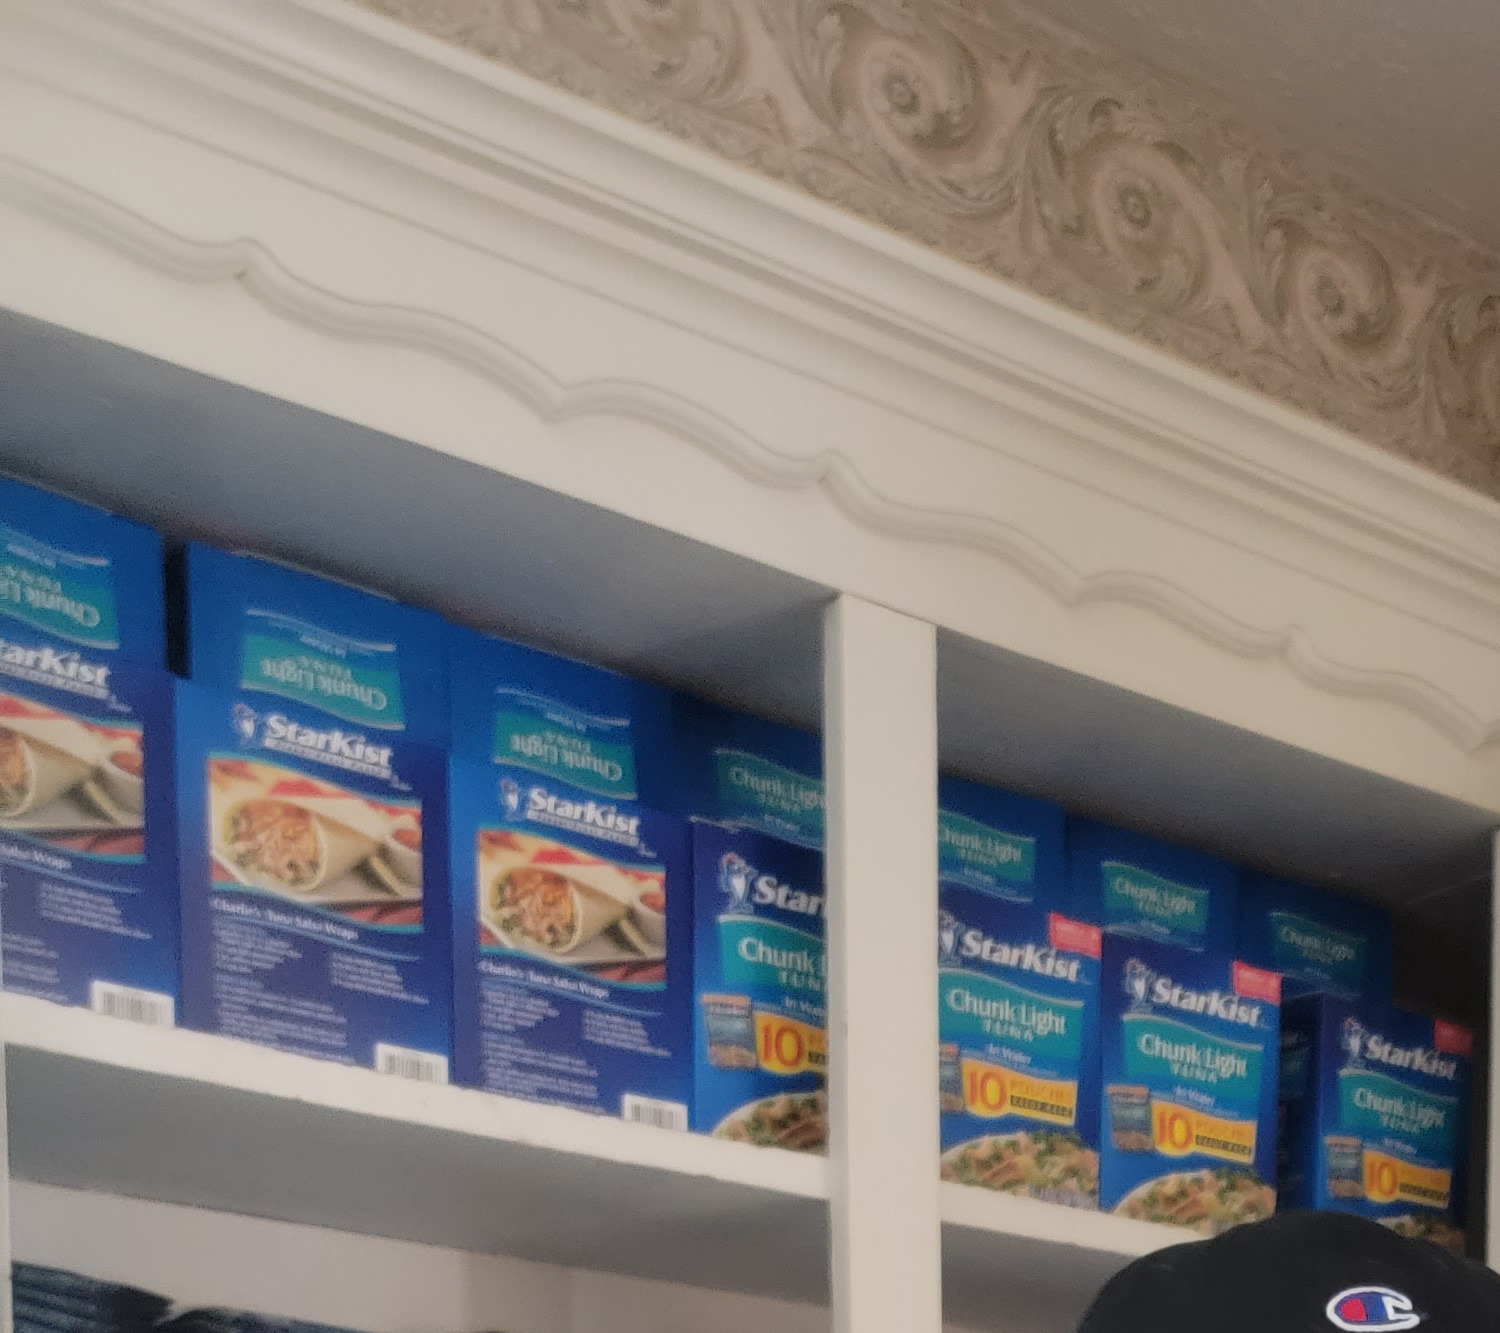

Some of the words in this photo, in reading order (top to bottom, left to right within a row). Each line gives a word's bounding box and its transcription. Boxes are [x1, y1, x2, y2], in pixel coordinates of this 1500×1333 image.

[0, 637, 112, 688] arKist
[260, 657, 315, 693] Light
[318, 674, 388, 711] Chunk
[266, 713, 394, 767] StarKist
[510, 734, 560, 765] Light
[563, 750, 624, 782] Chunk
[729, 766, 788, 797] Chunk
[790, 783, 825, 809] Ligh
[528, 786, 643, 836] StarKist
[940, 826, 987, 849] hunk
[754, 875, 825, 915] Star
[738, 935, 821, 974] Chunk
[962, 928, 1081, 983] StarKist
[779, 968, 826, 992] TUN
[948, 987, 1016, 1021] Chunk
[1021, 1004, 1067, 1036] Light
[1152, 975, 1262, 1028] StarKist
[761, 1022, 804, 1069] 10
[981, 1019, 1034, 1042] TUNA
[1137, 1033, 1203, 1066] Chunk
[1205, 1049, 1248, 1079] Light
[1170, 1060, 1218, 1084] TUNA
[1364, 1034, 1458, 1081] StarKist
[967, 1070, 1008, 1111] 10
[1353, 1087, 1406, 1117] Chunk
[1408, 1099, 1447, 1130] Light
[1157, 1110, 1194, 1150] 10
[1366, 1159, 1398, 1200] 10
